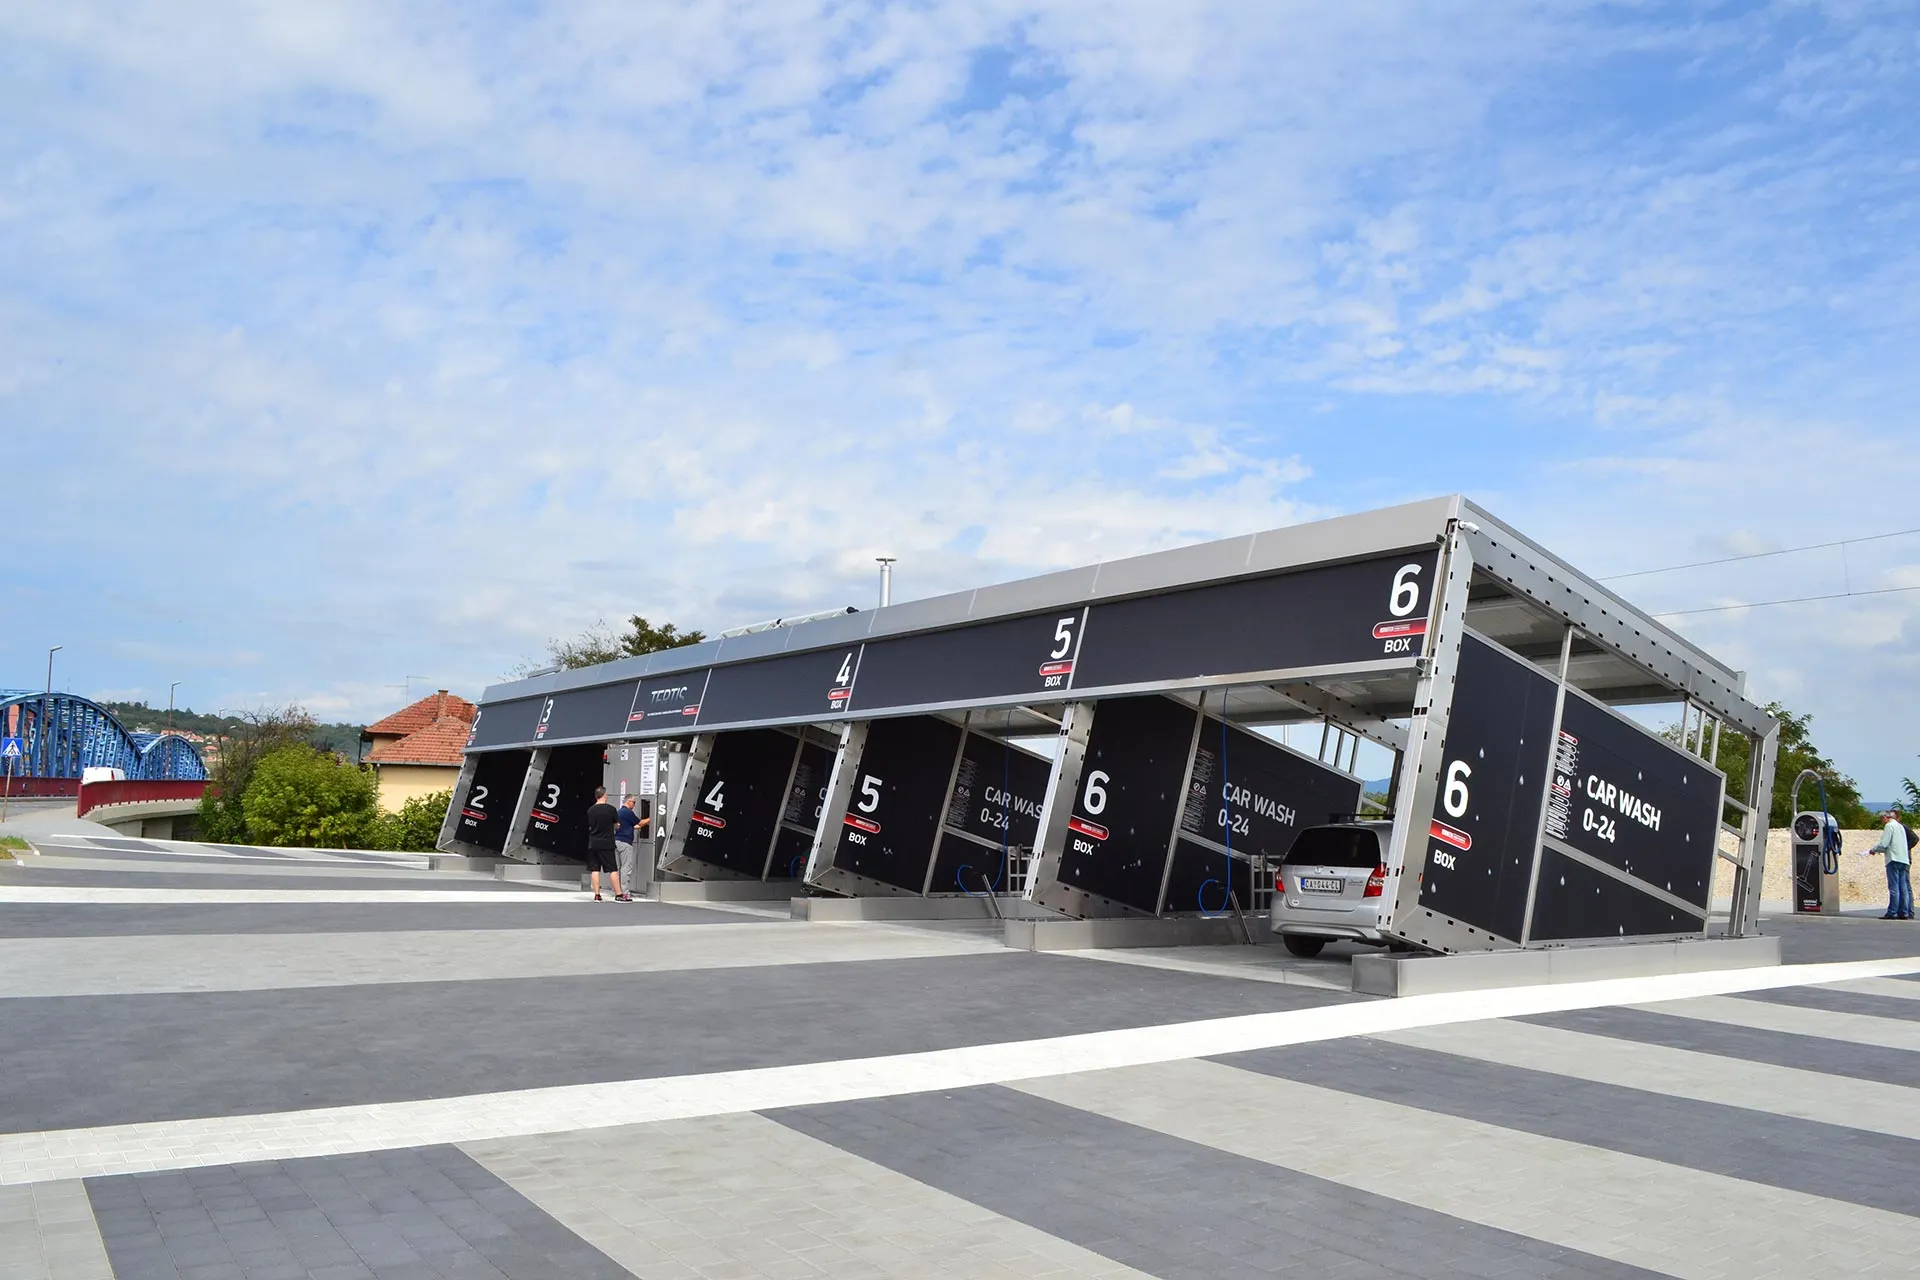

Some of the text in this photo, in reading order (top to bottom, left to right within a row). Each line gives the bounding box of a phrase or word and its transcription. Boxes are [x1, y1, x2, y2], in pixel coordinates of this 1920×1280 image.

[1389, 563, 1423, 617] 6
[1050, 617, 1075, 660] 5
[1383, 638, 1412, 653] BOX
[835, 652, 852, 687] 4
[1044, 675, 1063, 688] BOX
[542, 699, 554, 723] 3
[830, 699, 844, 710] BOX
[471, 710, 482, 732] 2
[470, 785, 489, 809] 2
[541, 783, 561, 809] 3
[704, 780, 725, 812] 4
[857, 774, 883, 813] 5
[1083, 769, 1111, 815] 6
[1443, 759, 1472, 818] 6
[984, 786, 1044, 819] CAR WAS
[1222, 782, 1296, 827] CAR WASH
[1586, 774, 1662, 832] CAR WASH
[464, 818, 478, 828] BOX
[534, 821, 549, 831] BOX
[980, 807, 1010, 830] 0-24
[1217, 808, 1250, 836] 0-24
[1583, 808, 1616, 843] 0-24
[697, 826, 714, 839] BOX
[848, 831, 867, 846] BOX
[1073, 838, 1094, 856] BOX
[1433, 849, 1457, 871] BOX
